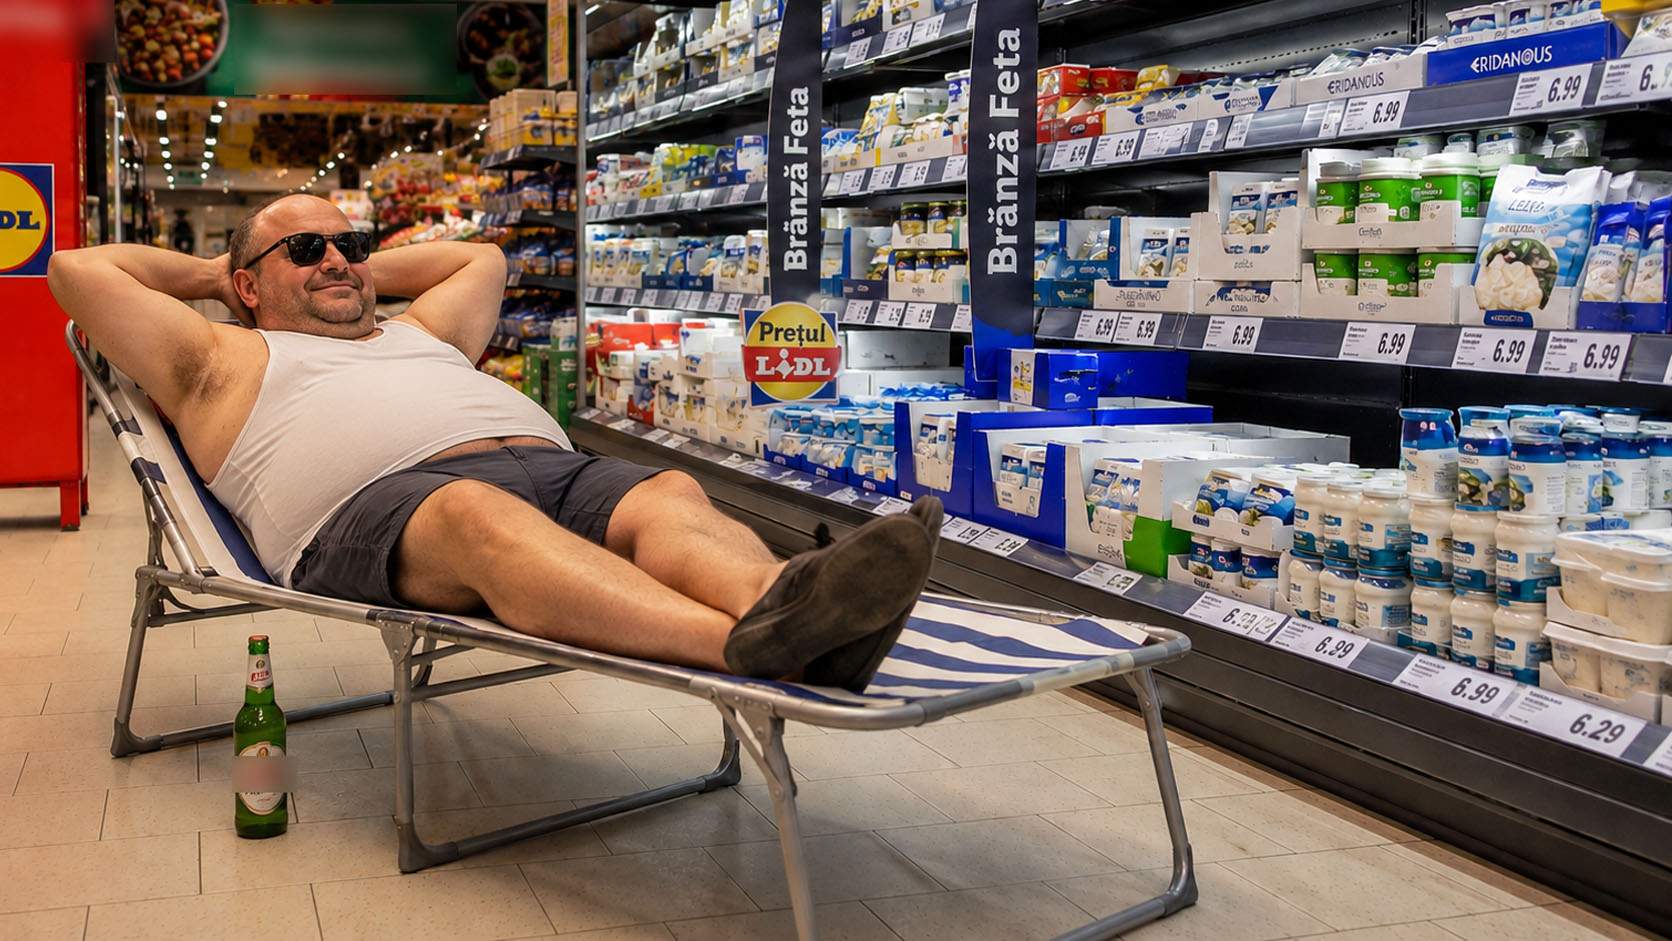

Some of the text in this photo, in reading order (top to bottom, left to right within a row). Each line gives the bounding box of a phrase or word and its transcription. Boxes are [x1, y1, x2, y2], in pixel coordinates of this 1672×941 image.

[988, 27, 1021, 118] Feta
[1470, 45, 1553, 74] ERIDANOUS
[1327, 71, 1385, 95] ERIDANOUS
[1547, 74, 1582, 103] 6.99
[783, 86, 809, 155] Feta
[1372, 100, 1400, 125] 6.99
[0, 210, 41, 230] DL
[759, 321, 826, 347] Prețul
[1136, 319, 1156, 339] 6.99
[1232, 325, 1256, 346] 6.99
[1377, 332, 1406, 355] 6.99
[1493, 338, 1526, 364] 6.99
[1583, 343, 1621, 370] 6.99
[755, 348, 831, 380] LIDL
[1314, 636, 1355, 661] 6.99
[1450, 677, 1501, 705] 6.99
[1568, 713, 1626, 744] 6.29
